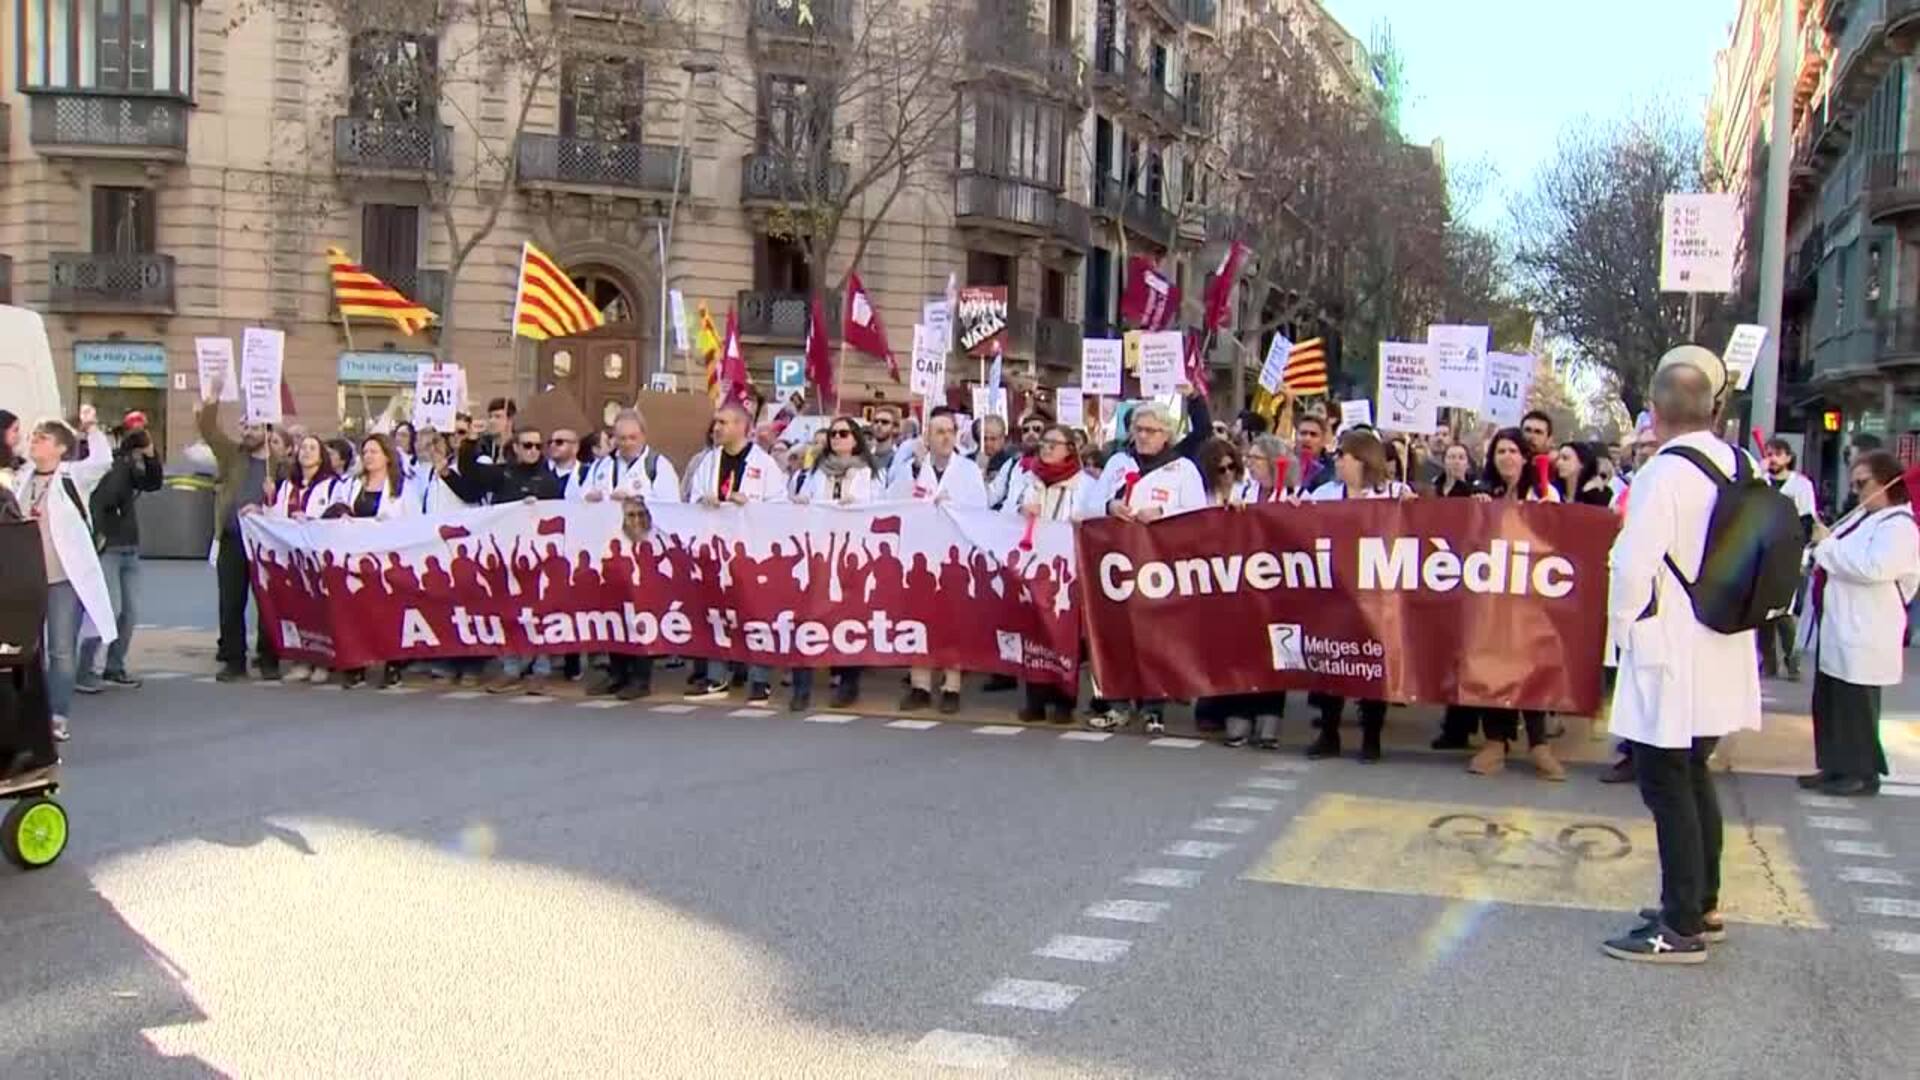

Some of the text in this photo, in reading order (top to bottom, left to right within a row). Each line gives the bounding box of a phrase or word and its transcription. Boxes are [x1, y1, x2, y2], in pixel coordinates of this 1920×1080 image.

[781, 360, 800, 384] P
[422, 389, 452, 405] JA!
[1489, 379, 1519, 399] JA!
[1099, 537, 1575, 602] Conveni Mèdic
[401, 601, 928, 656] A tu també t'afecta
[1304, 635, 1383, 659] Metges de
[1307, 655, 1383, 681] Catalunya
